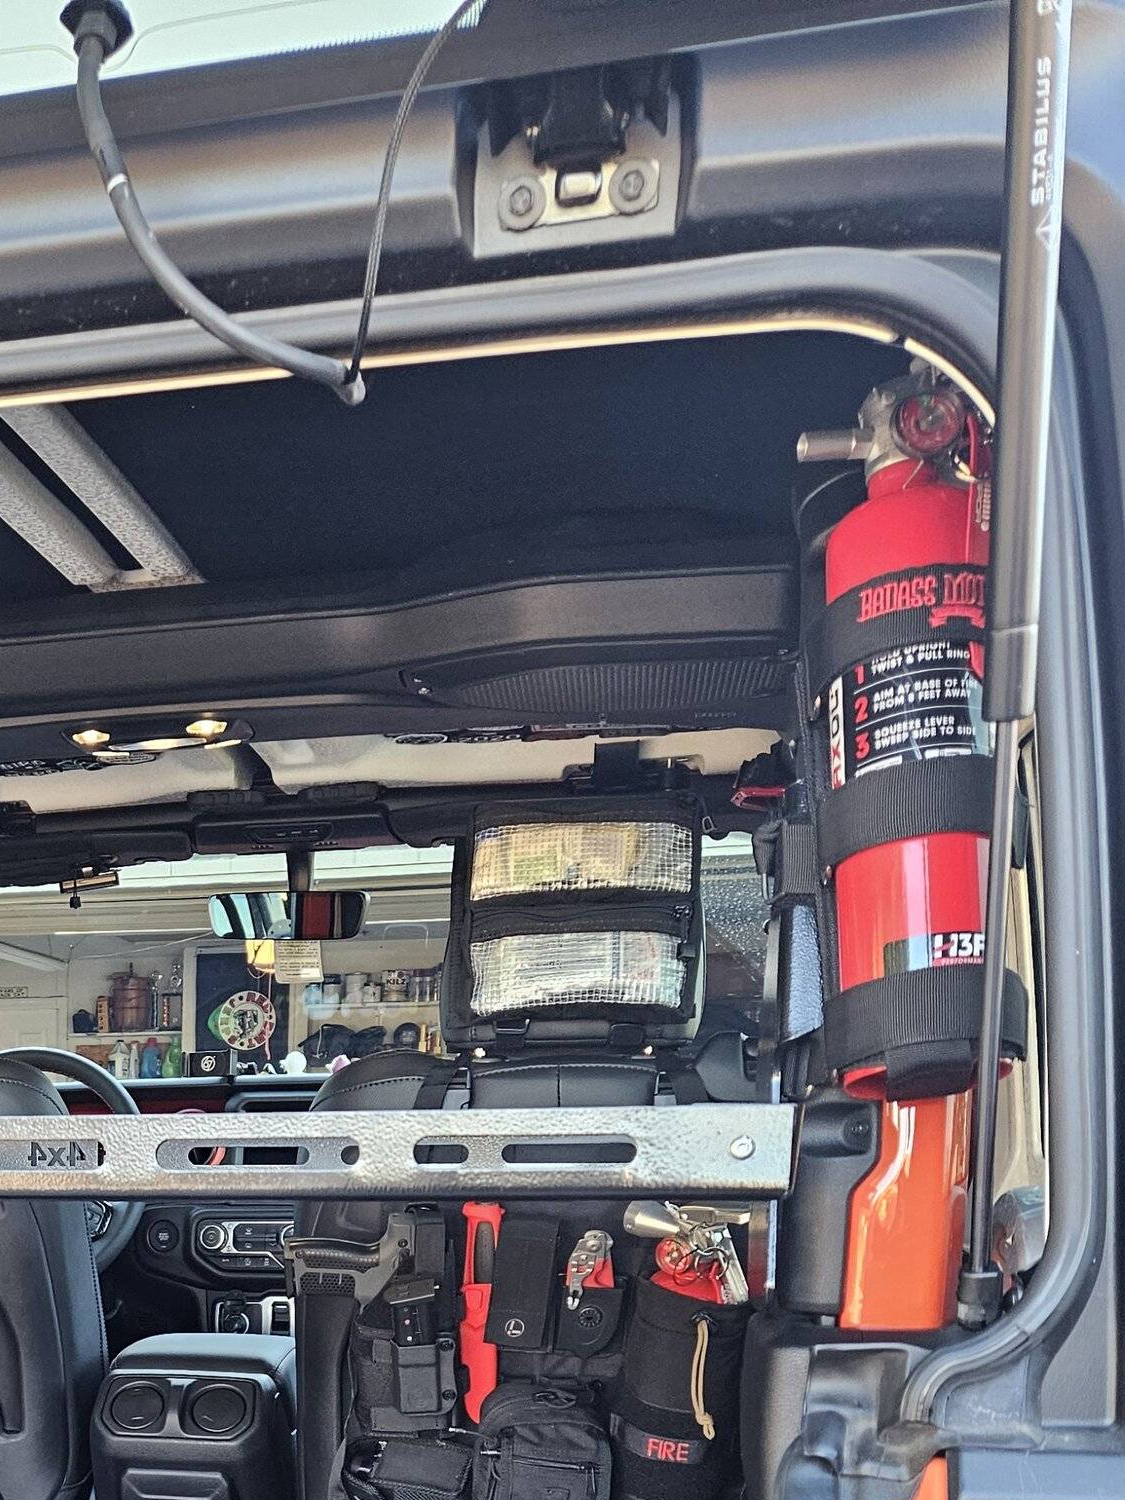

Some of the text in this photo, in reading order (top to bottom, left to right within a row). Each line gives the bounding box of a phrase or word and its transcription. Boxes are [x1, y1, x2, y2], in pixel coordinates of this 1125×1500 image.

[1031, 56, 1052, 207] STABILUS
[856, 575, 938, 622] BADASS
[854, 664, 865, 685] 1
[871, 649, 971, 676] TWIST & PULL RING
[873, 687, 894, 702] AIM
[897, 681, 911, 697] AT
[914, 679, 942, 692] BASE
[944, 678, 959, 688] OF
[873, 694, 905, 713] FROM
[918, 689, 942, 702] FEET
[944, 688, 972, 699] AWAY
[854, 696, 869, 723] 2
[874, 715, 955, 741] SQUEEZE LEVER
[874, 731, 910, 751] SWEEP
[911, 726, 937, 740] SIDE
[939, 725, 955, 736] TO
[854, 731, 870, 759] 3
[646, 1437, 690, 1461] FIRE
